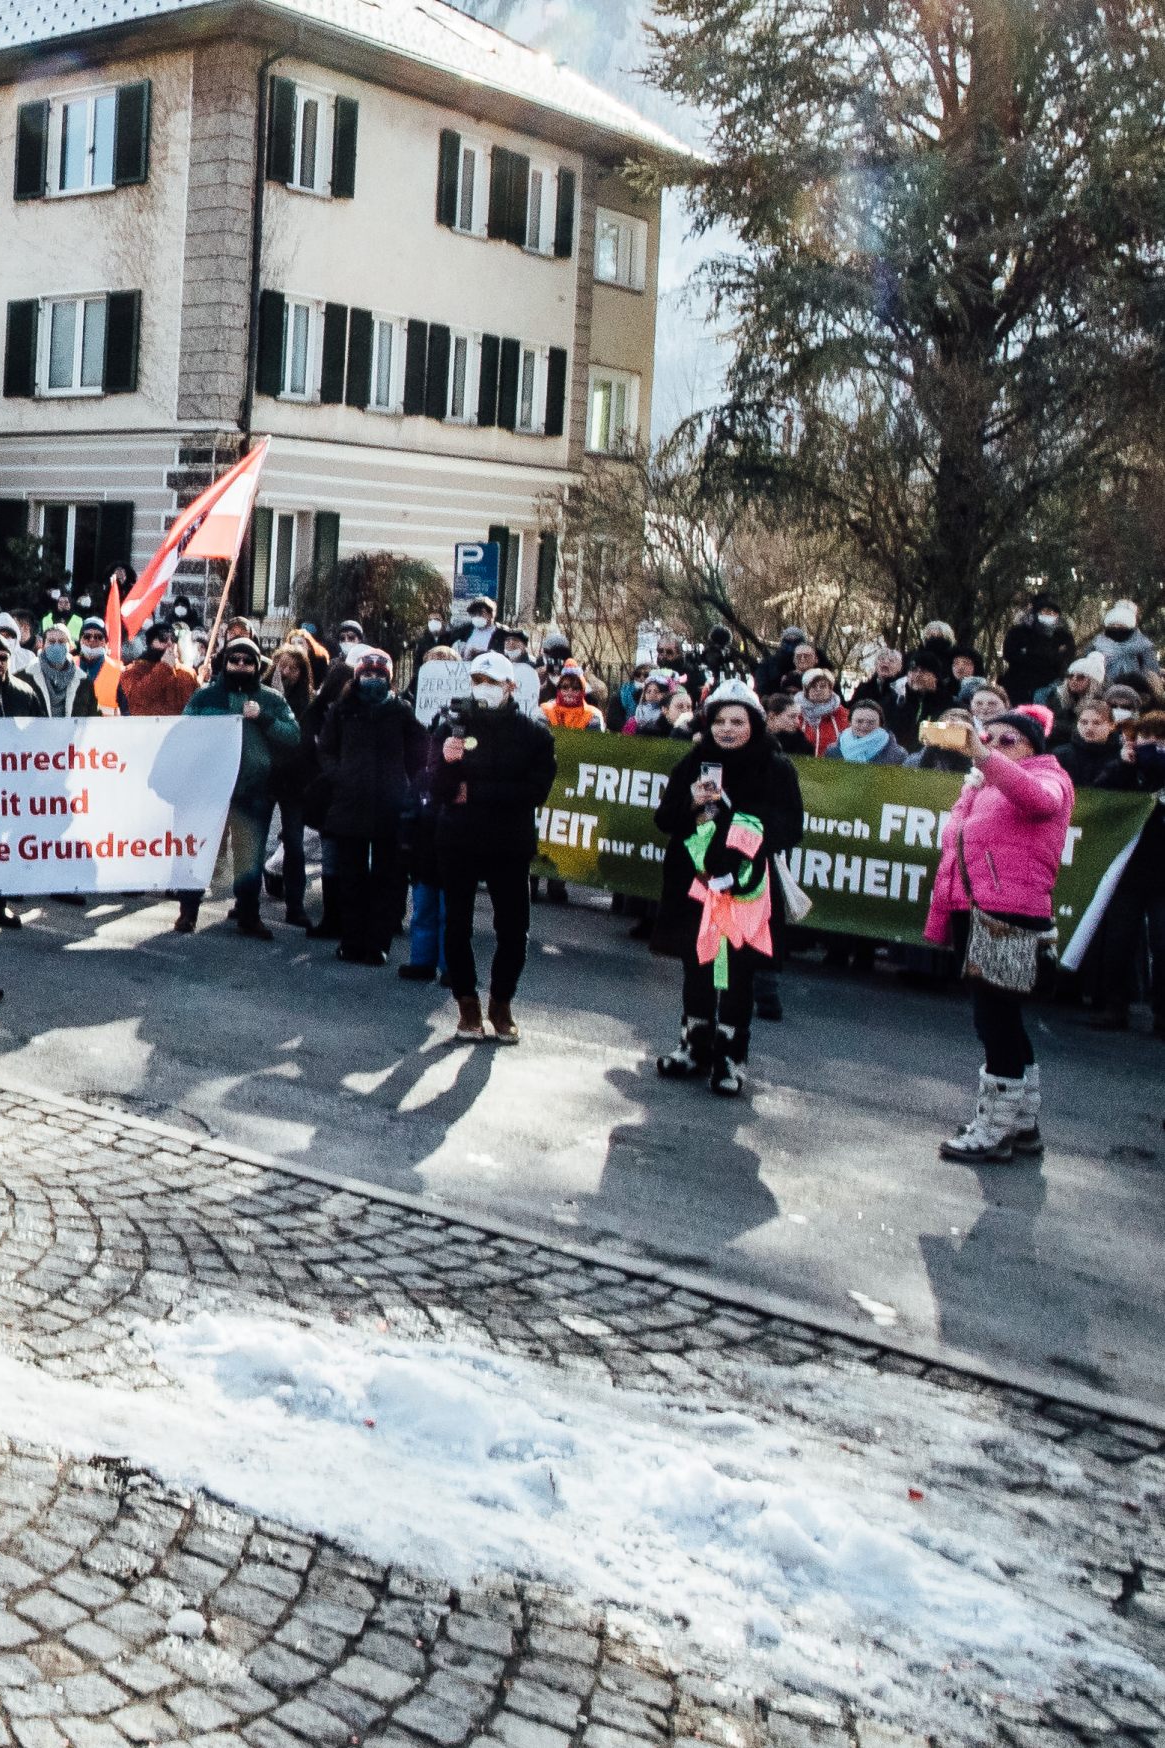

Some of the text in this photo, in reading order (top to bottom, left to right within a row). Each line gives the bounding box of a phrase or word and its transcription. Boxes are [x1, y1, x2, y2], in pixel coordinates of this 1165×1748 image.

[457, 545, 484, 575] P
[29, 788, 89, 815] und
[597, 838, 635, 857] nur
